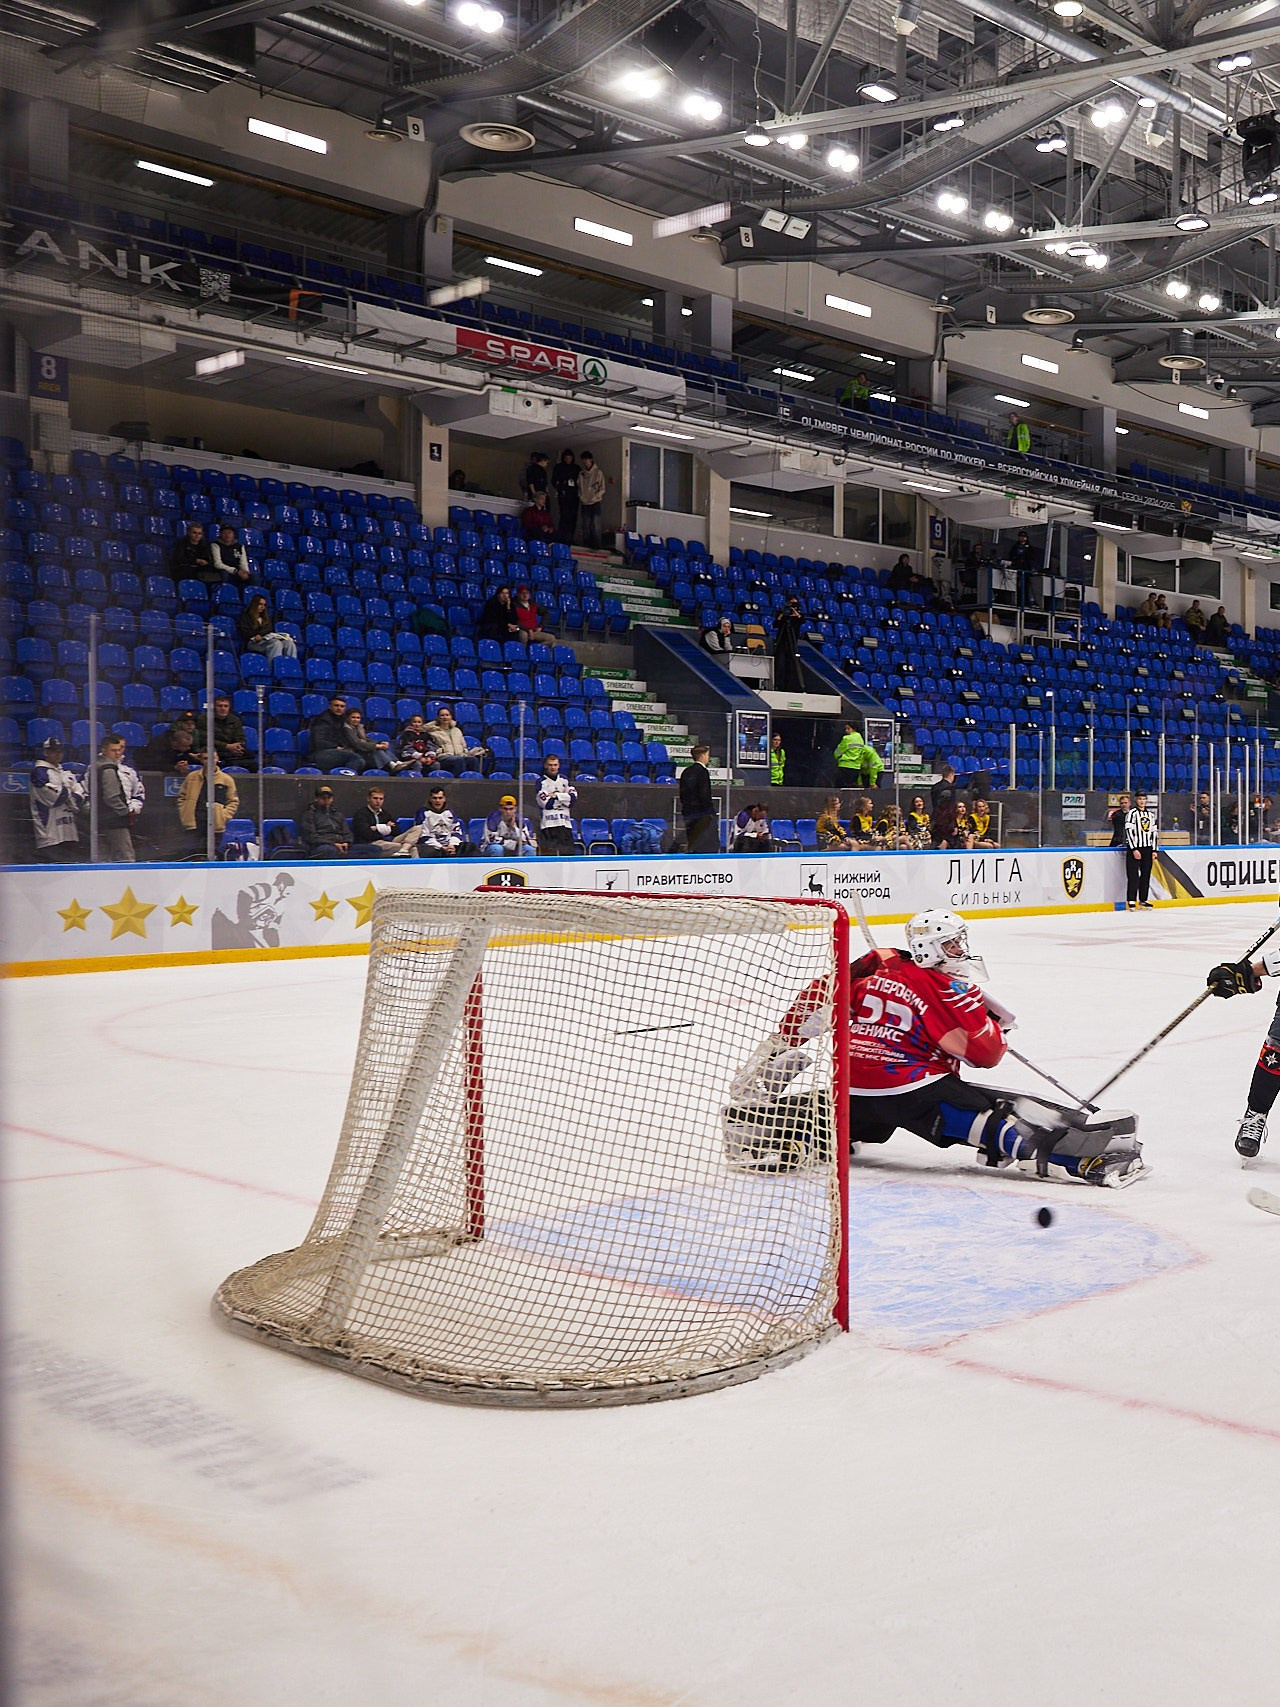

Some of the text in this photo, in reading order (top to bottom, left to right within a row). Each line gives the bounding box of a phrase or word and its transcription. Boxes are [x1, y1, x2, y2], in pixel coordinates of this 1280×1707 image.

[412, 123, 420, 135] 9
[744, 232, 750, 242] 8
[0, 221, 182, 292] ANK
[485, 339, 576, 373] SPAR
[41, 355, 56, 380] 8
[801, 416, 849, 436] OLIMPBET
[850, 428, 903, 448] ЧЕМПИОНАТ
[905, 442, 938, 458] РОССИИ
[940, 449, 952, 460] ПО
[954, 452, 986, 468] ХОККЕЮ
[997, 463, 1059, 484] ВСЕРОССИЙСКАЯ
[1060, 476, 1100, 493] ХОККЕЙНАЯ
[1101, 486, 1118, 499] ЛИГА
[934, 522, 942, 538] 9
[606, 682, 634, 690] SYNERGETIC
[626, 703, 654, 711] SYNERGETIC
[647, 724, 674, 732] SYNERGETIC
[1064, 796, 1084, 804] PARI
[834, 870, 881, 884] НИЖНИЙ
[947, 857, 1023, 885] ЛИГА
[637, 873, 734, 886] ПРАВИТЕЛЬСТВО
[950, 890, 1022, 906] СИЛЬНЫХ
[850, 1023, 904, 1043] ФЕНИКС
